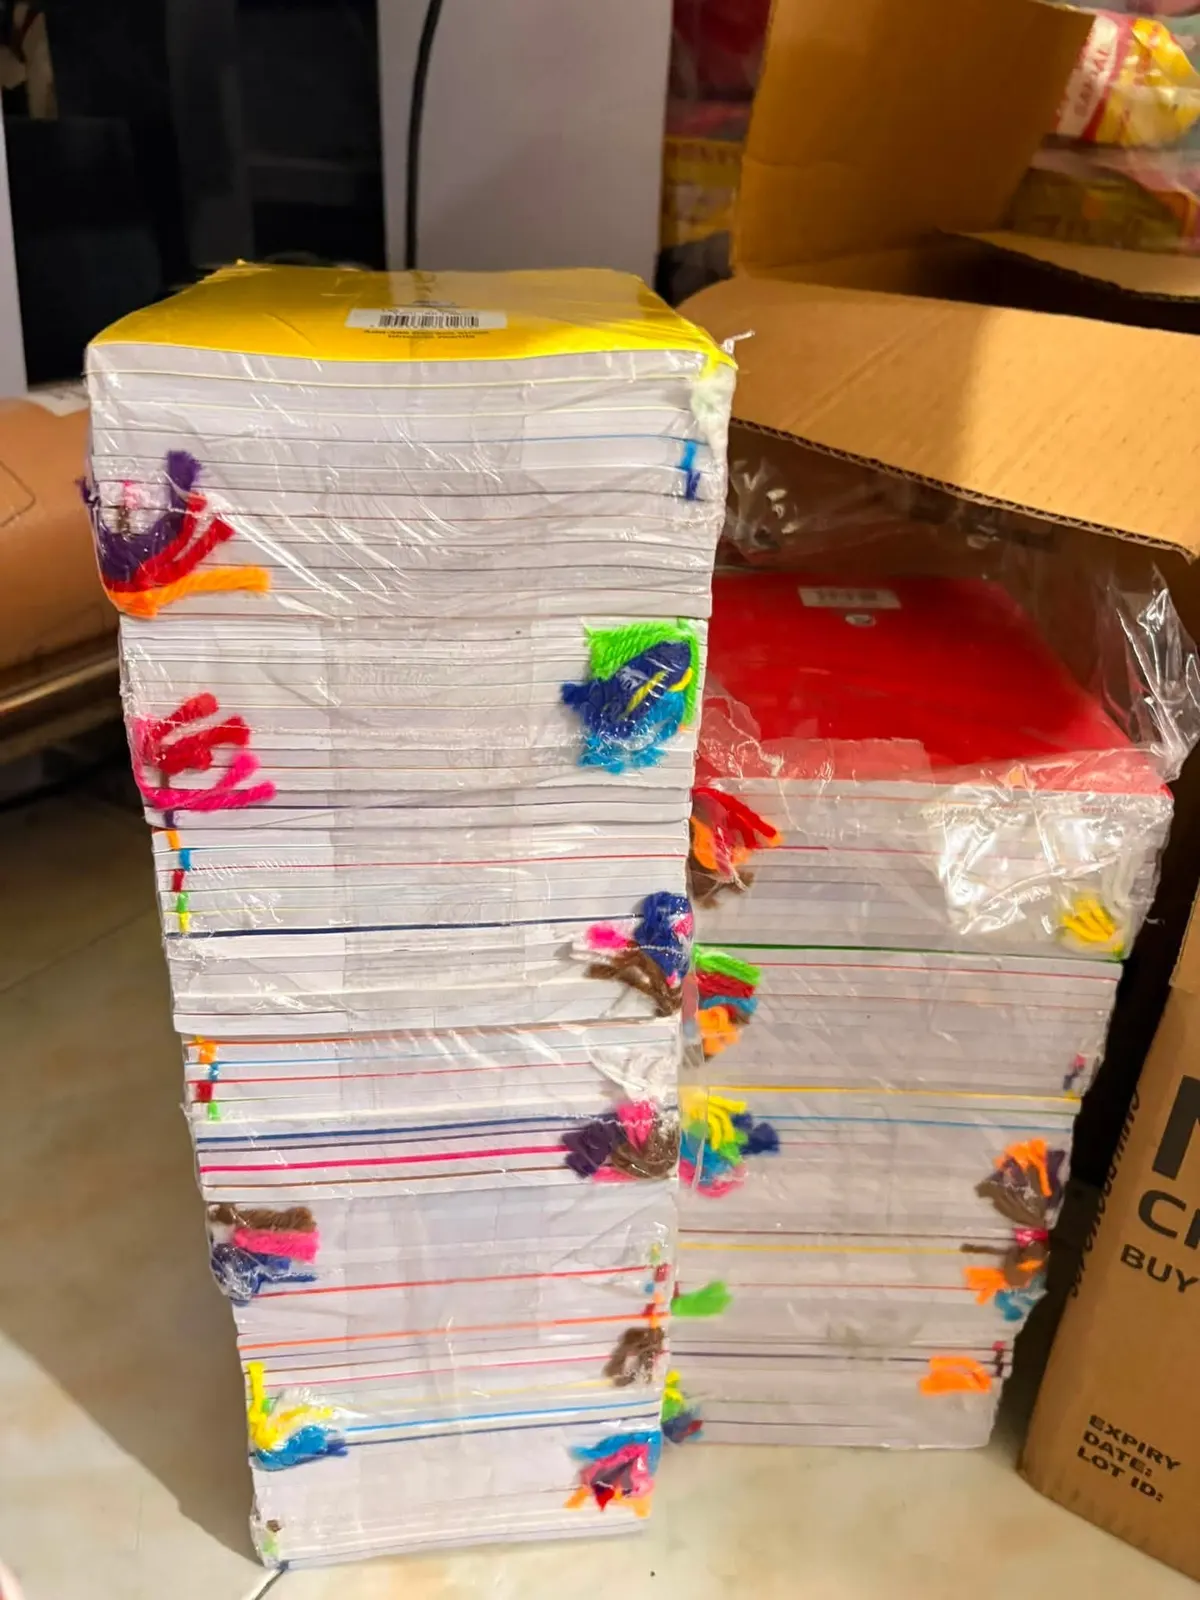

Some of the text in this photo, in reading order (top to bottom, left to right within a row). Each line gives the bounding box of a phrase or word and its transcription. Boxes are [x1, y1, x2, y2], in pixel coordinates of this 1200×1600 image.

[1120, 1243, 1199, 1293] BUY
[1083, 1431, 1152, 1477] DATE:
[1089, 1415, 1181, 1470] EXPIRY
[1077, 1446, 1164, 1502] LOT ID:
